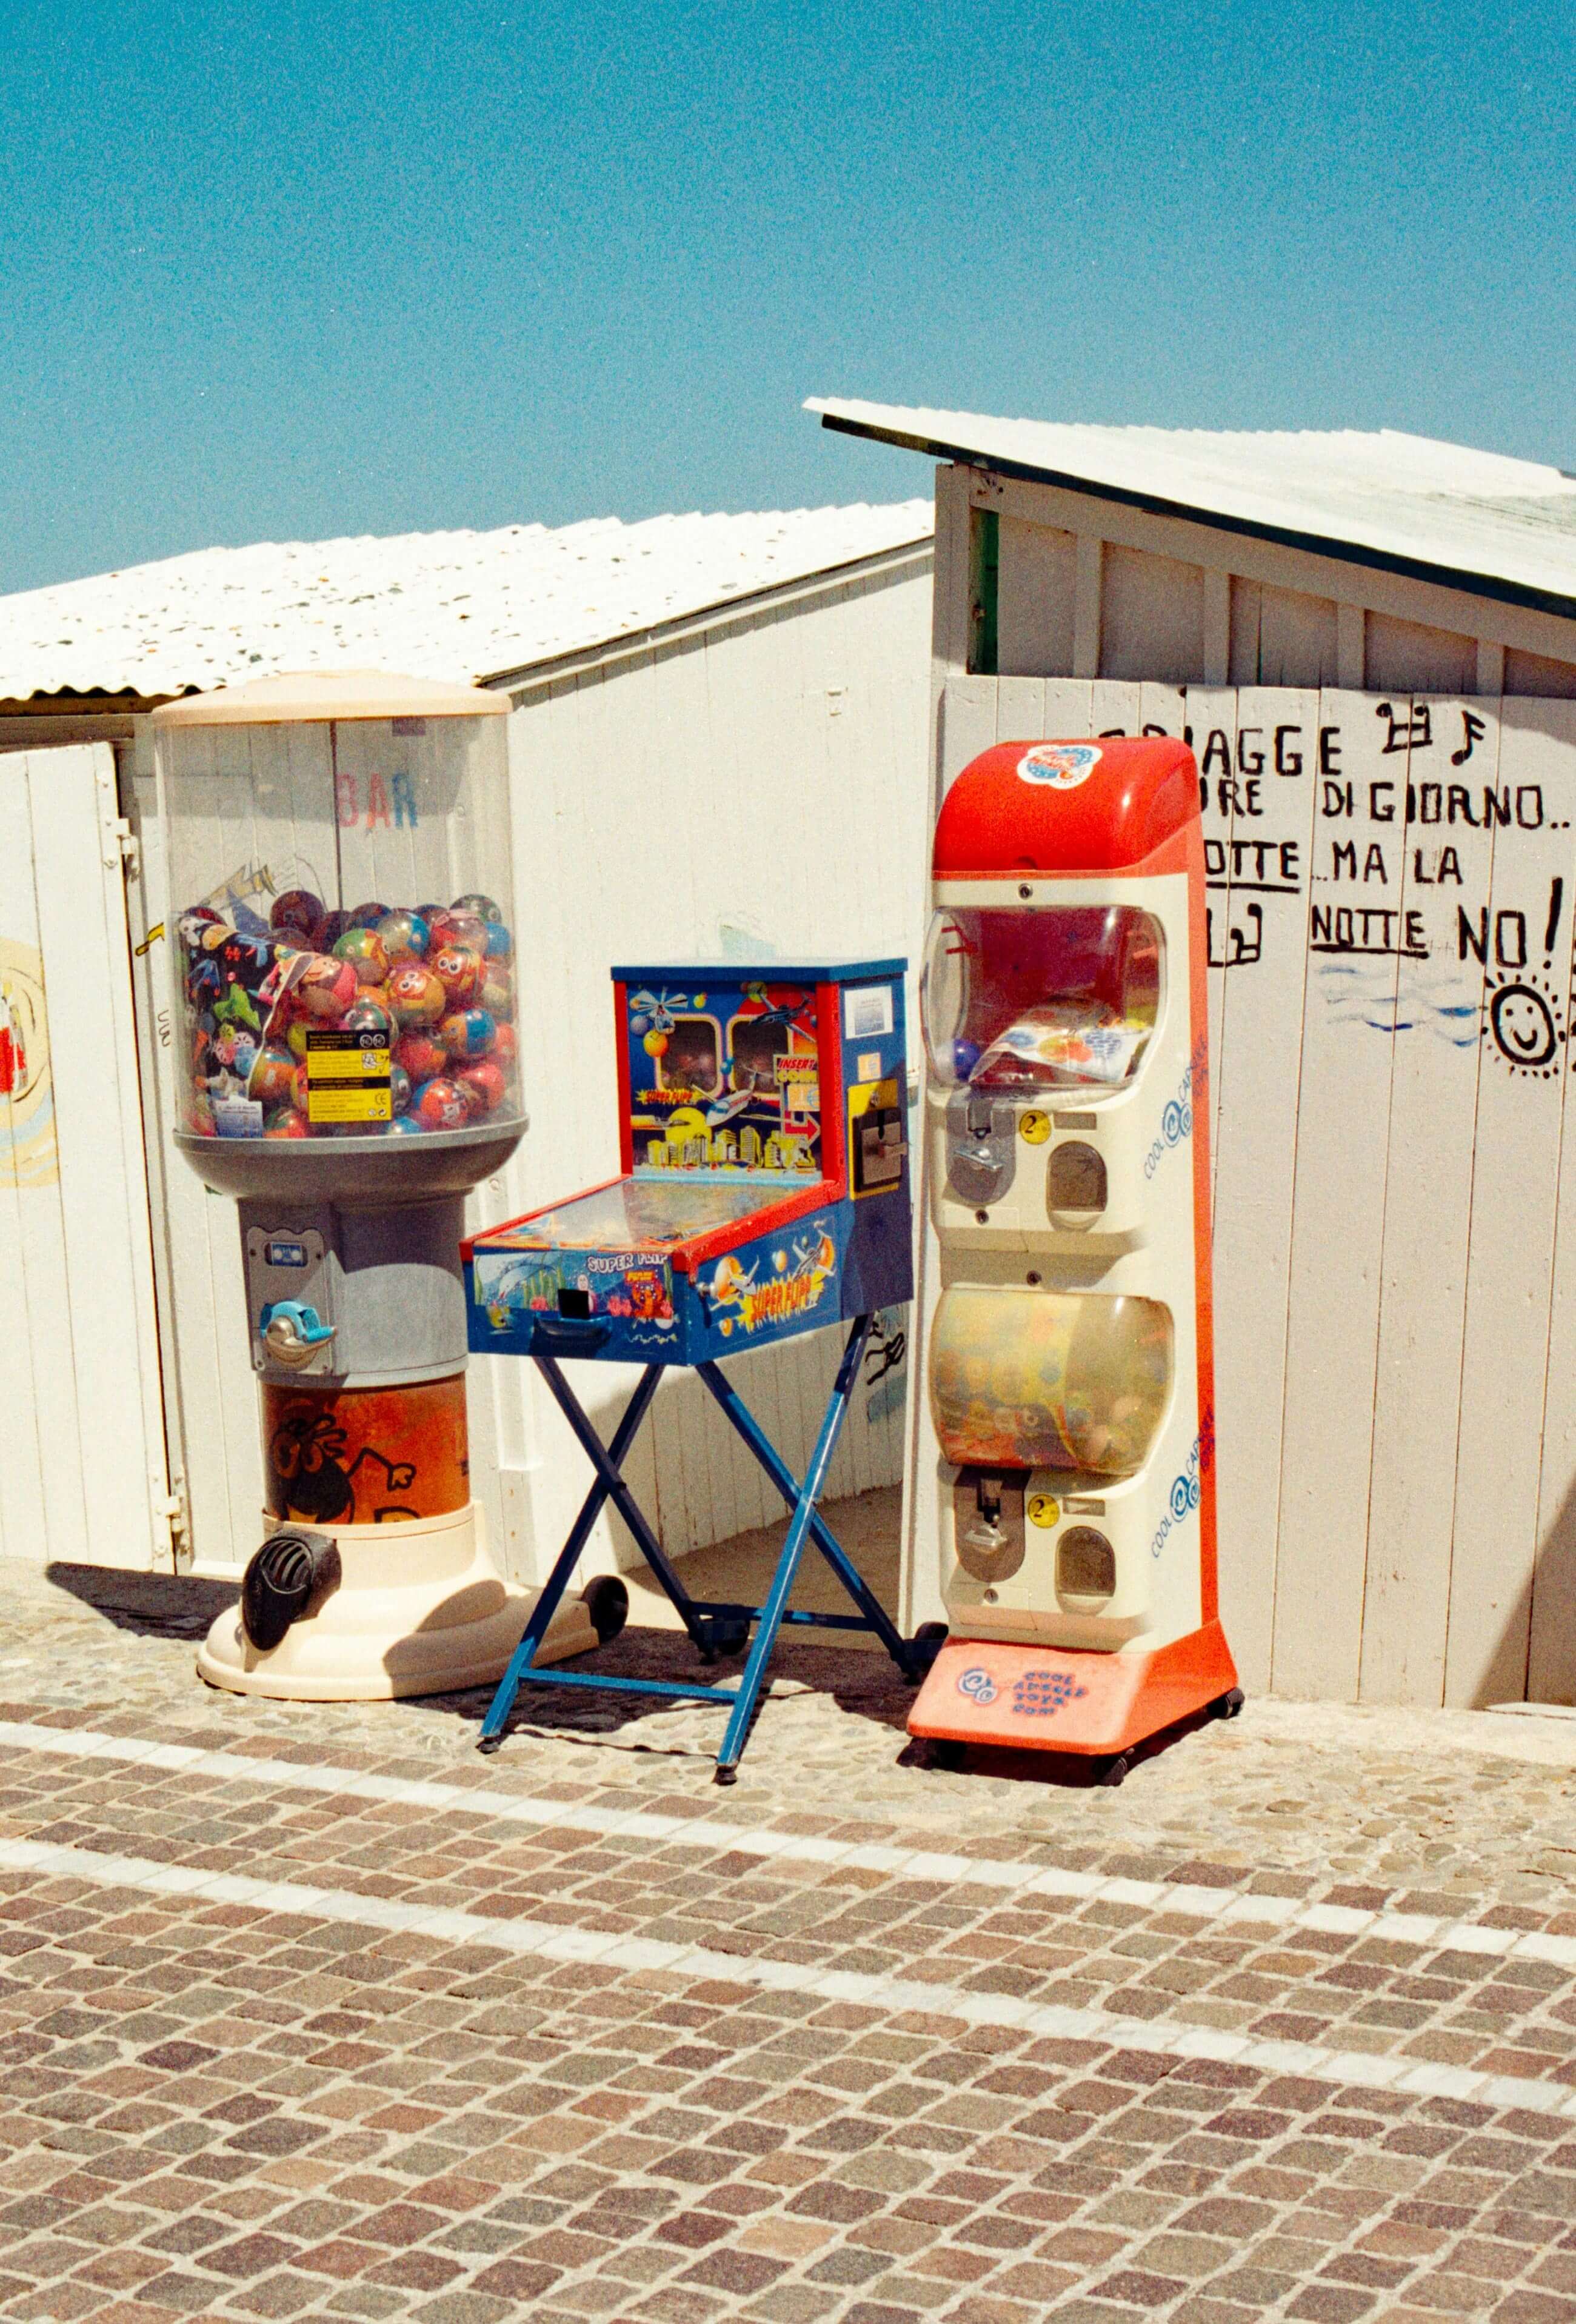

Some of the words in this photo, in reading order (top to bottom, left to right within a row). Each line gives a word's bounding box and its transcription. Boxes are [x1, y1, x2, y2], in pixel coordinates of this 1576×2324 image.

[1098, 724, 1343, 778] AGGE
[337, 773, 418, 829] BAR
[1322, 781, 1354, 818] DI
[1414, 846, 1463, 885] LA
[1311, 905, 1427, 949] NOTTE
[1457, 876, 1563, 970] NO!
[777, 1070, 817, 1083] COIN
[778, 1058, 815, 1070] INSERT
[1024, 1114, 1037, 1134] 2
[1144, 1138, 1164, 1180] COOL
[587, 1253, 635, 1273] SUPER
[636, 1253, 669, 1265] FLIP
[1033, 1499, 1045, 1518] 2
[1152, 1516, 1172, 1559] COOL
[1024, 1671, 1072, 1685] COOL
